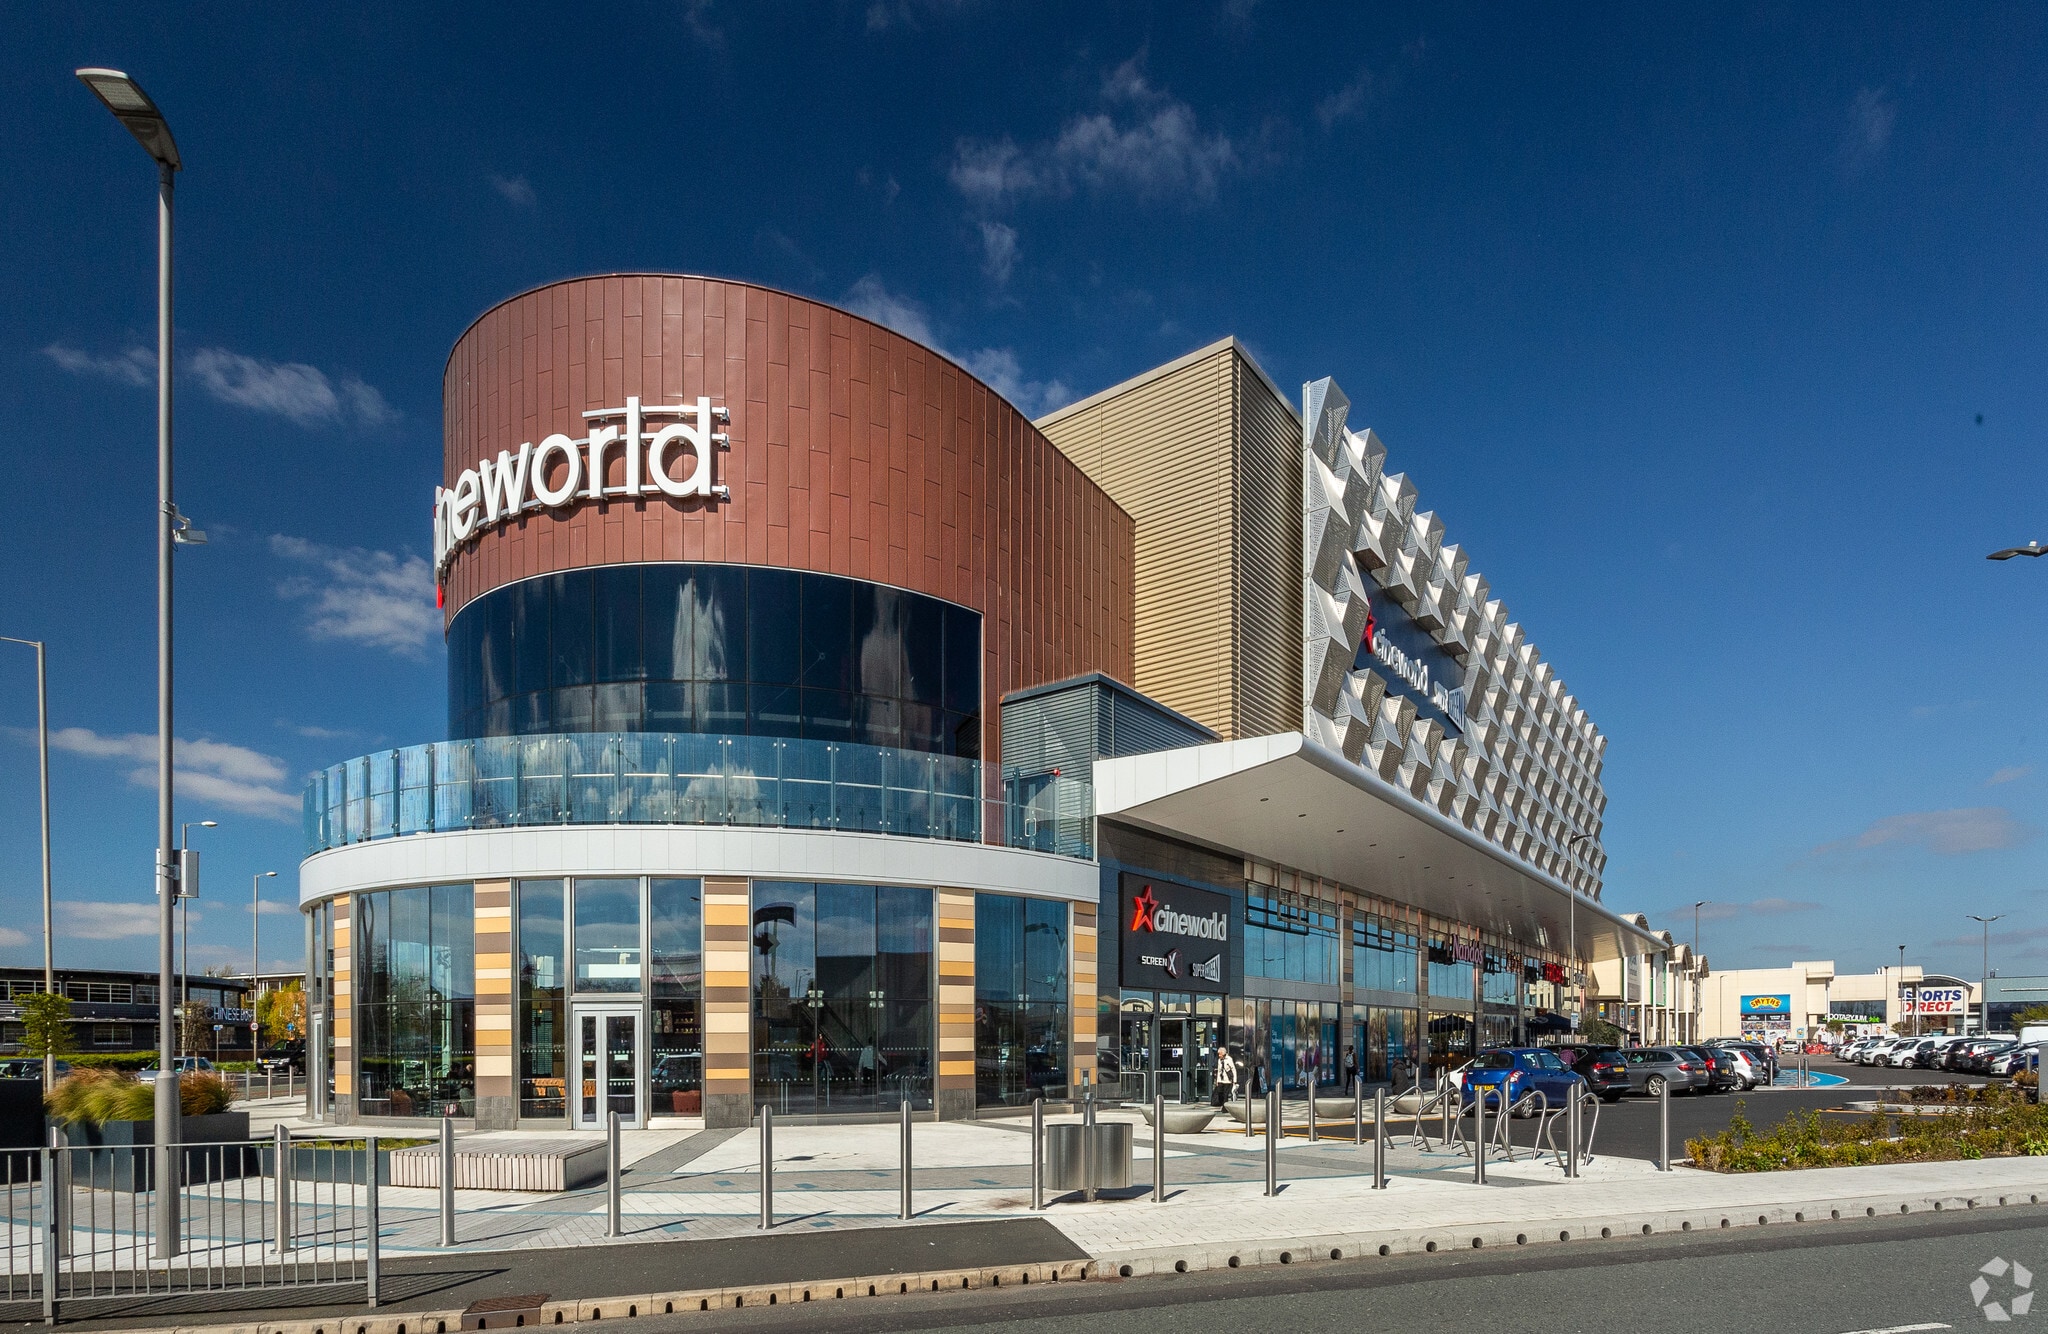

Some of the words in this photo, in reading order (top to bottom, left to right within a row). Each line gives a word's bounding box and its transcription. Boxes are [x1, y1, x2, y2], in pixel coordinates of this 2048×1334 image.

[1153, 904, 1227, 941] cineworld
[1905, 990, 1962, 1001] SORTS
[1750, 998, 1780, 1008] SMYTHS
[1903, 1002, 1953, 1012] DRECT
[204, 1006, 241, 1021] CHINESE
